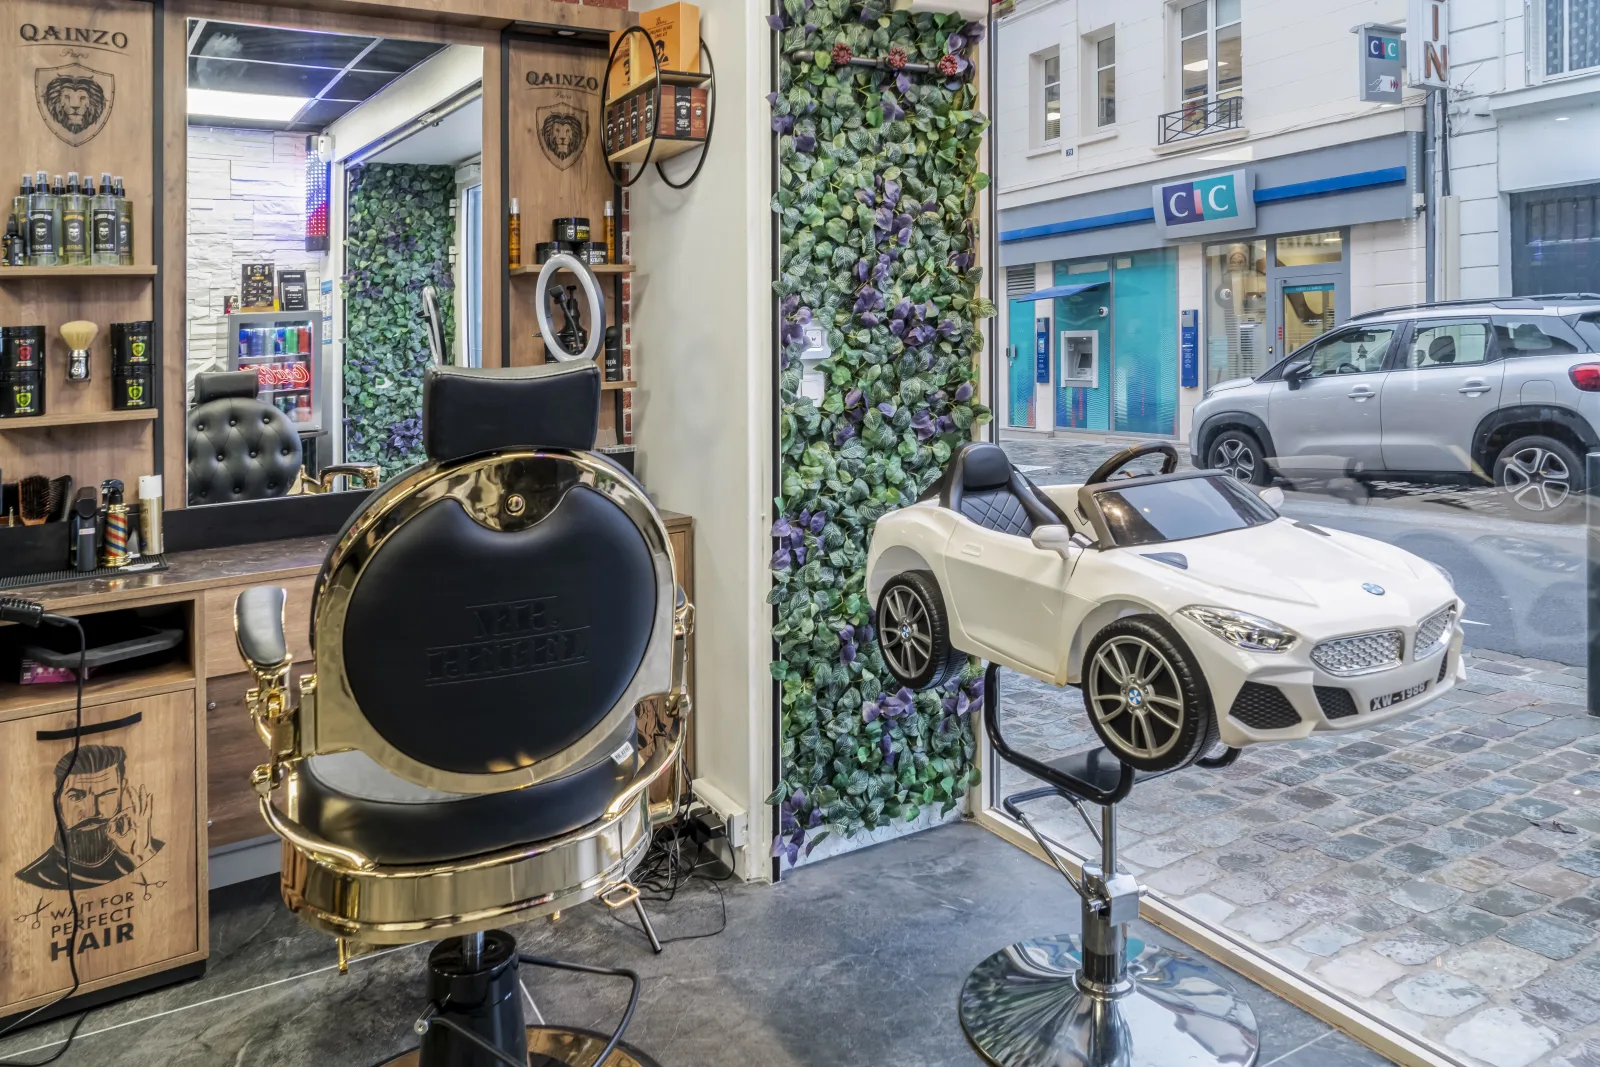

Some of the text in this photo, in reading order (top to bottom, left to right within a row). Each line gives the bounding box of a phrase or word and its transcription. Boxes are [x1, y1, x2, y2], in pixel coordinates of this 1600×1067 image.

[19, 23, 128, 49] QAINZO
[1370, 40, 1397, 57] CIC
[59, 48, 89, 58] Paris
[525, 70, 599, 91] QAINZO
[1169, 184, 1229, 218] CIC
[50, 891, 134, 921] WAIT FOR
[51, 905, 135, 938] PERFECT
[50, 922, 135, 962] HAIR
